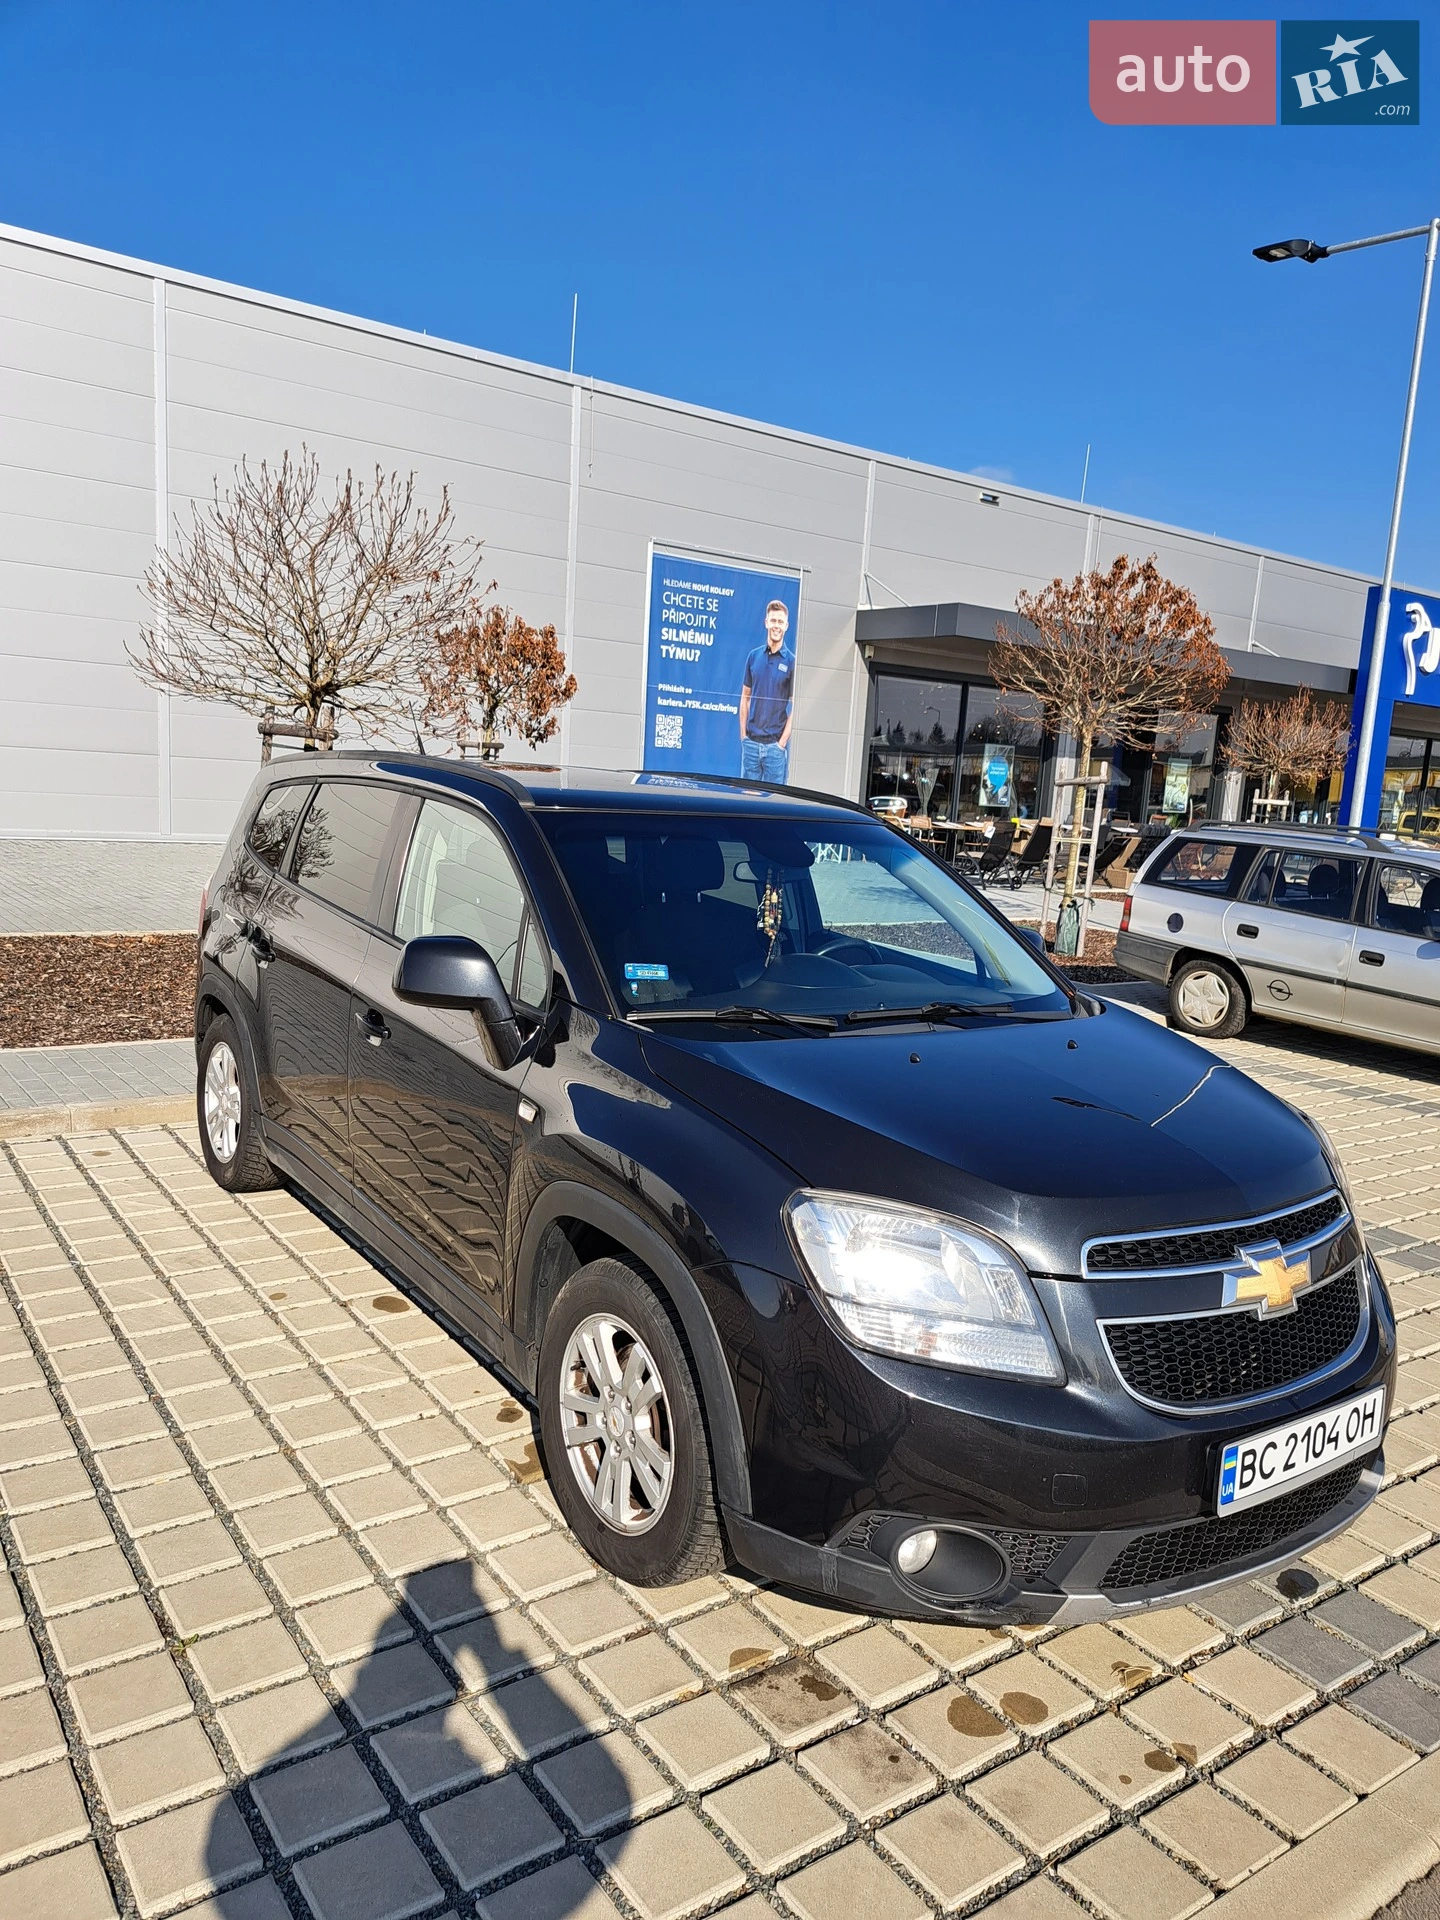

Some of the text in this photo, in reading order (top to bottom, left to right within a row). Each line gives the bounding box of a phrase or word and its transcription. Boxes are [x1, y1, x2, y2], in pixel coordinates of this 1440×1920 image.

[663, 578, 735, 597] HLEDÁME NOVÉ KOLEGY
[662, 591, 719, 612] CHCETE SE
[662, 607, 717, 629] PŘIPOJIT K
[661, 627, 714, 646] SILNÉMU
[660, 643, 701, 662] TÝMU?
[1239, 1398, 1377, 1490] BC 2104 OH
[1222, 1482, 1234, 1496] UA
